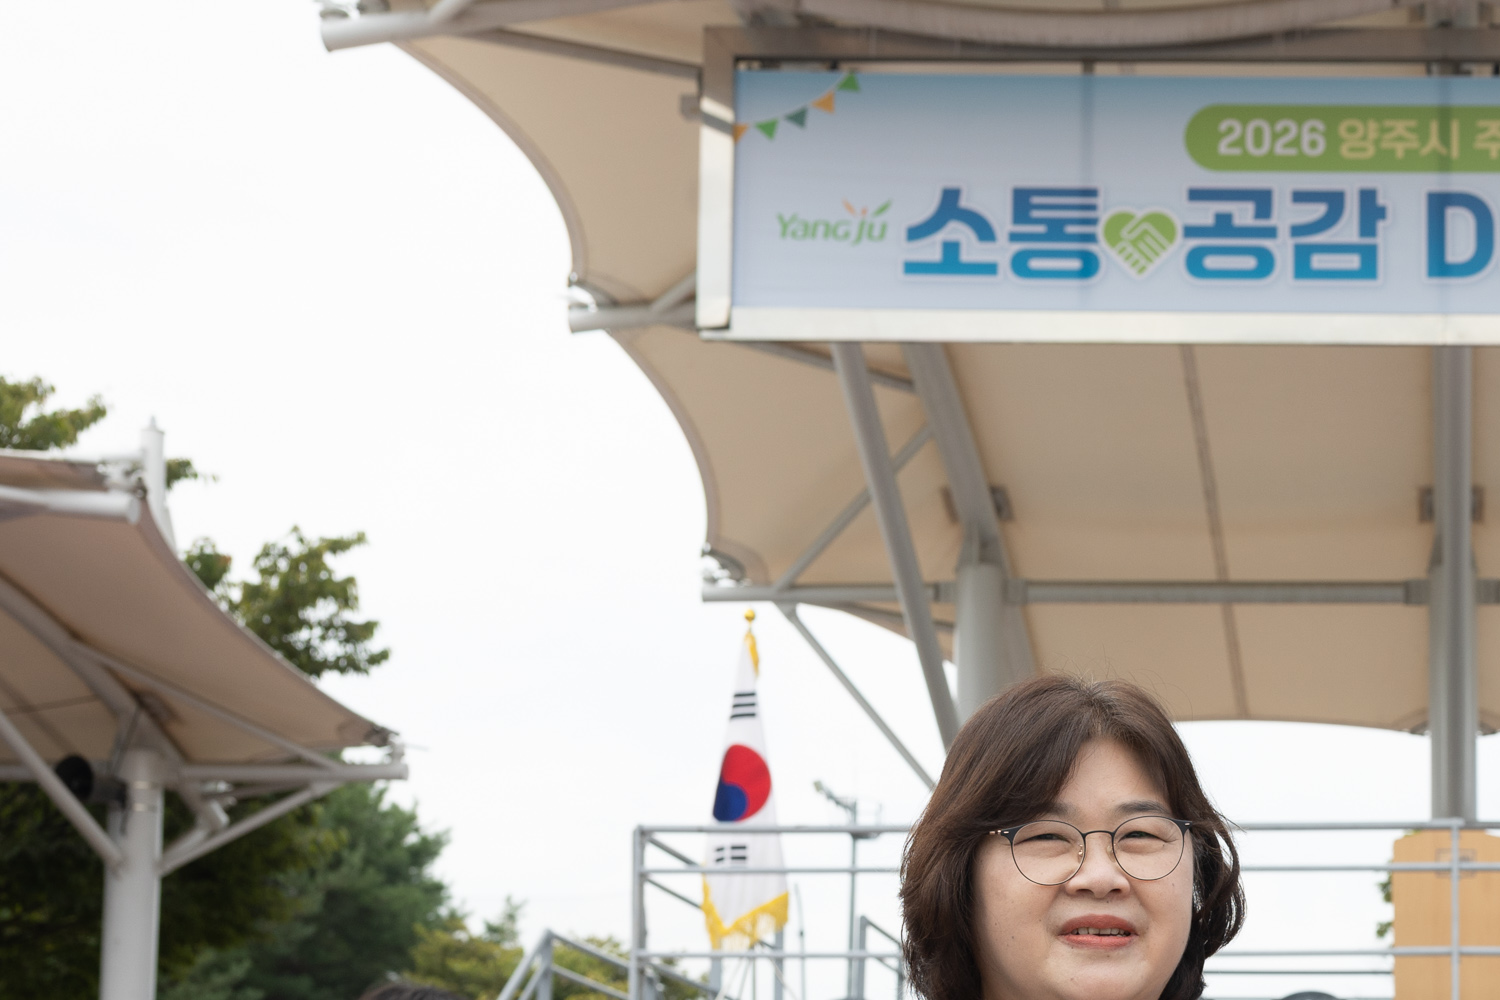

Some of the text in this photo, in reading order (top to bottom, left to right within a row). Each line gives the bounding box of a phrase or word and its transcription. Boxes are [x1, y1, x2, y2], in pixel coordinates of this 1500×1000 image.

[1216, 118, 1328, 158] 2026
[1338, 118, 1461, 160] 양주시
[902, 187, 1101, 280] 소통
[1182, 187, 1387, 280] 공감
